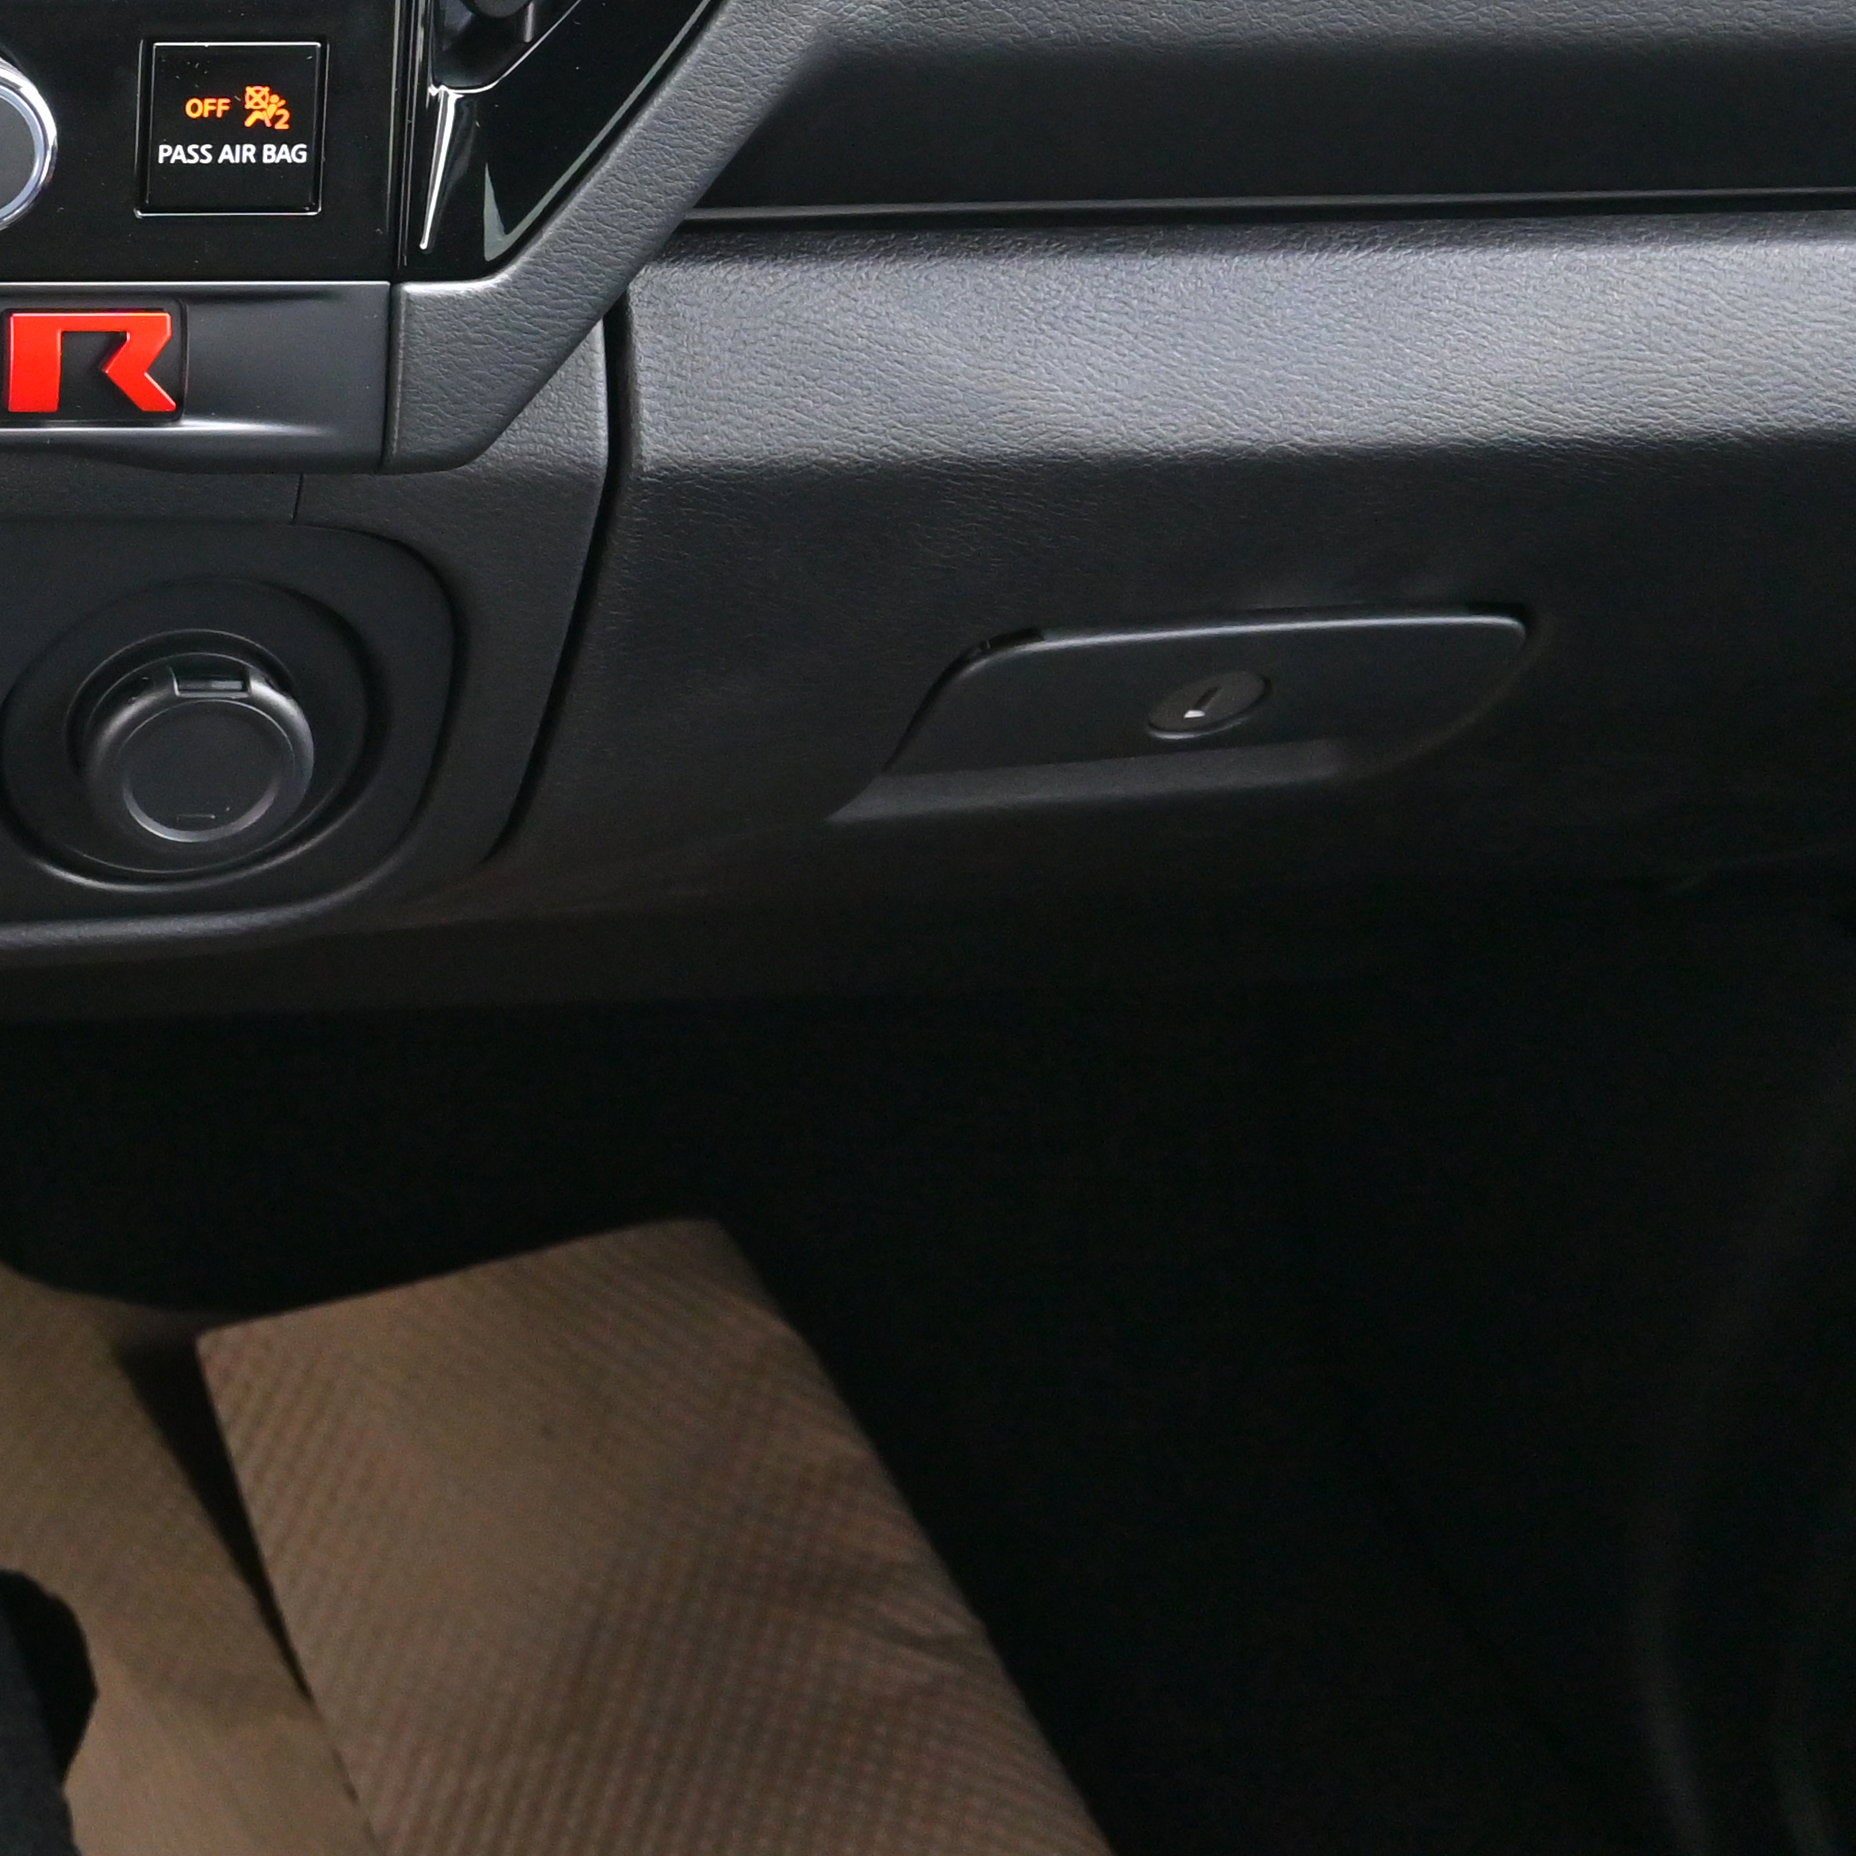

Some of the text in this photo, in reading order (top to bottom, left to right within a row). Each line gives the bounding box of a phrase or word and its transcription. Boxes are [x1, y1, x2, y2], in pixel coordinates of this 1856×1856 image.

[184, 97, 231, 119] OFF
[157, 143, 308, 166] PASS AIR BAG
